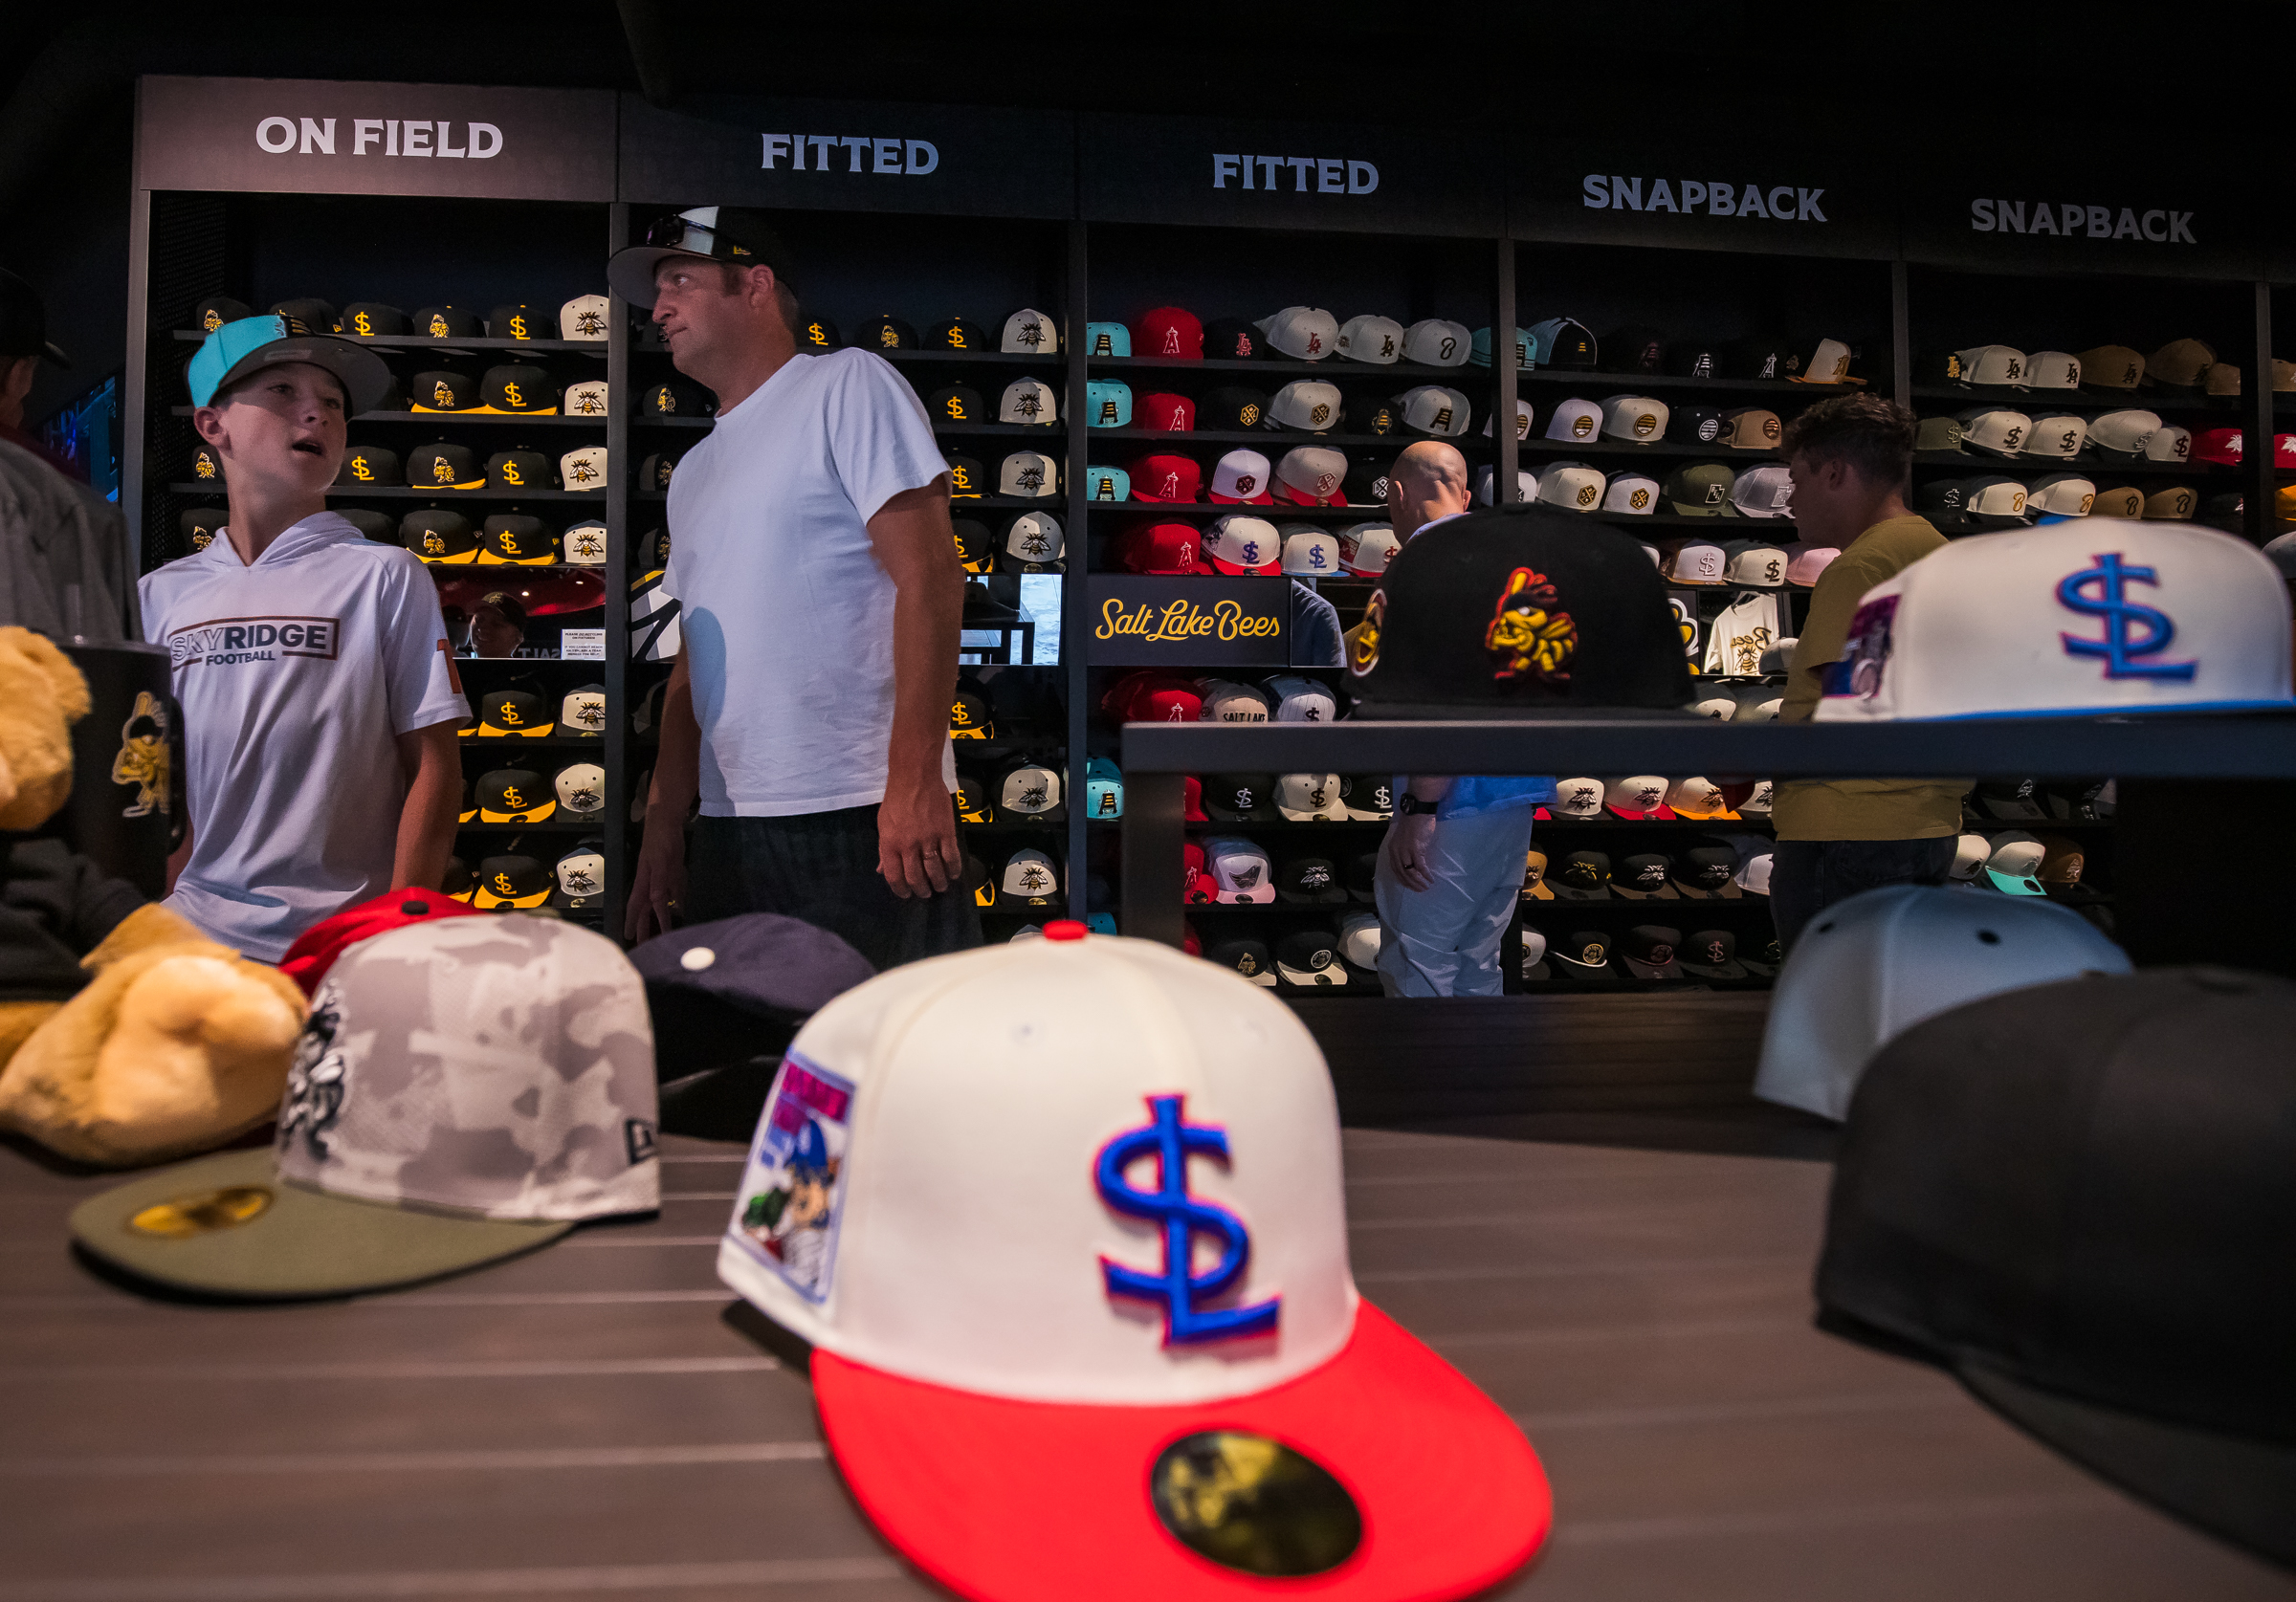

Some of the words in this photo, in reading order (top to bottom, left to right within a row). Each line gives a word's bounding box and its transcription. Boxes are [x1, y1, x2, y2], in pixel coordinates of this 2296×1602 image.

[255, 116, 337, 155] ON
[353, 118, 503, 159] FIELD
[762, 133, 938, 175] FITTED
[1212, 154, 1379, 194] FITTED
[1582, 174, 1827, 222] SNAPBACK
[1971, 198, 2197, 244] SNAPBACK
[1095, 599, 1153, 639] Salt
[1145, 600, 1214, 641] Lake
[1214, 600, 1280, 641] Bees
[206, 650, 276, 666] FOOTBALL
